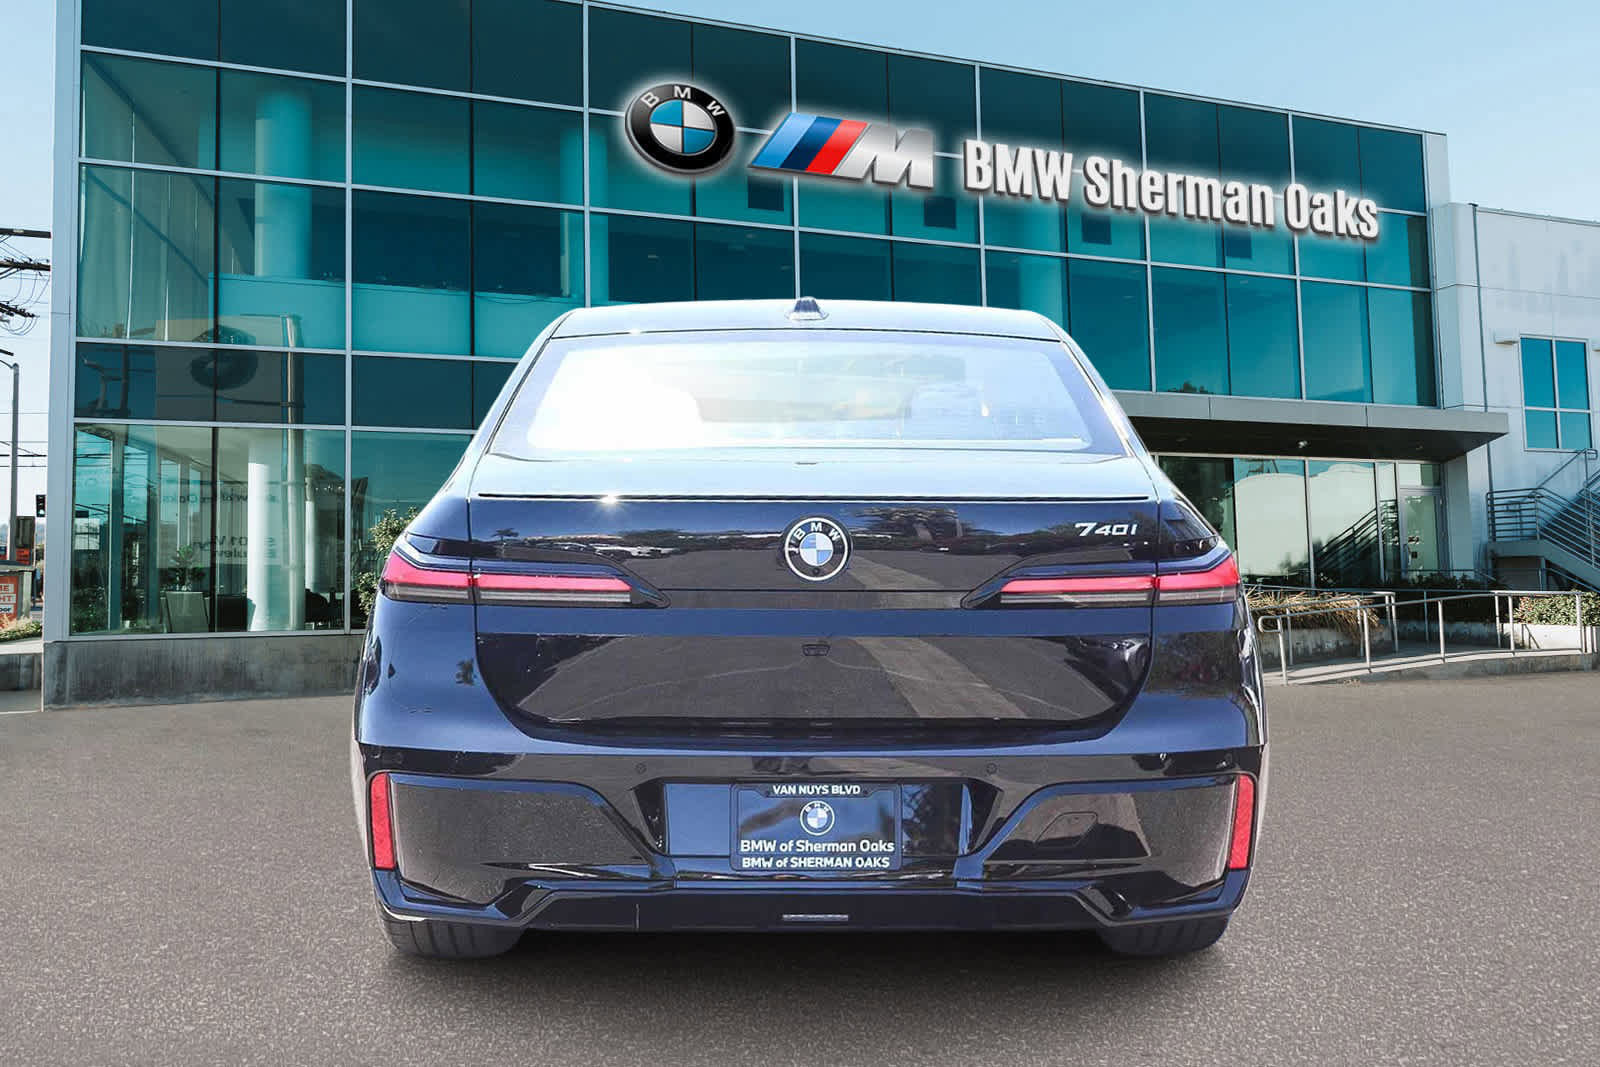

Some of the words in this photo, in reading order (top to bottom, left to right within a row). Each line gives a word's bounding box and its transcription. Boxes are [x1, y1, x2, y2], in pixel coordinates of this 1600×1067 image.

[641, 86, 725, 117] BMW
[963, 139, 1073, 200] BMW
[1083, 156, 1274, 226] Sherman
[1283, 183, 1380, 241] Oaks
[793, 522, 840, 541] BMW
[773, 785, 798, 795] VAN
[799, 785, 829, 795] NUYS
[831, 785, 861, 795] BLVD
[740, 840, 776, 852] BMW
[779, 840, 794, 852] of
[795, 840, 857, 852] Sherman
[859, 840, 895, 852] Oaks
[742, 857, 773, 868] BMW
[775, 857, 789, 868] of
[790, 857, 853, 868] SHERMAN
[855, 857, 890, 868] OAKS
